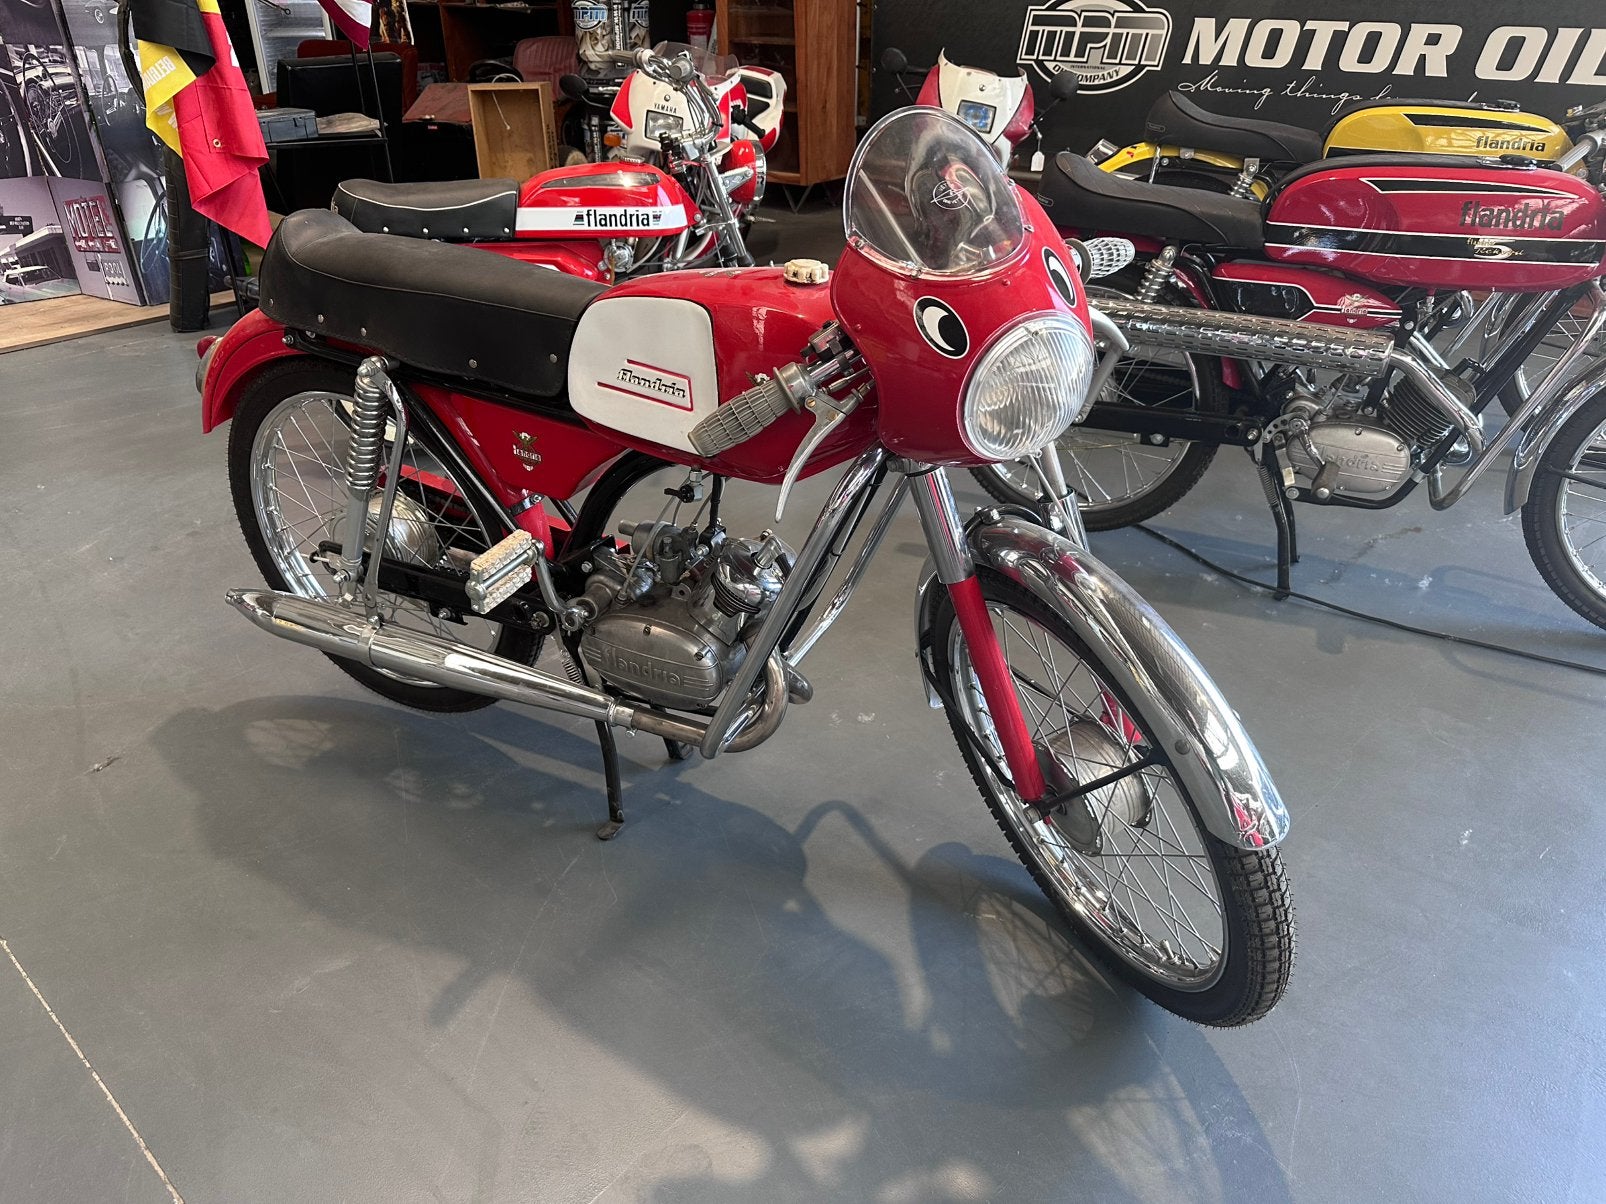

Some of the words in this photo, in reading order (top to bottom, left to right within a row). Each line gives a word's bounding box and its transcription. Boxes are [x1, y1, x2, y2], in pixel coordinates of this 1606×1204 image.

[1181, 17, 1463, 77] MOTOR
[1074, 68, 1121, 83] OMPANY
[1178, 70, 1274, 109] Moving
[1281, 76, 1362, 114] things
[654, 103, 677, 114] YAMAHA
[1476, 136, 1546, 152] flandria
[586, 209, 650, 227] flandria
[1459, 200, 1565, 231] flandria
[601, 645, 681, 686] flandria
